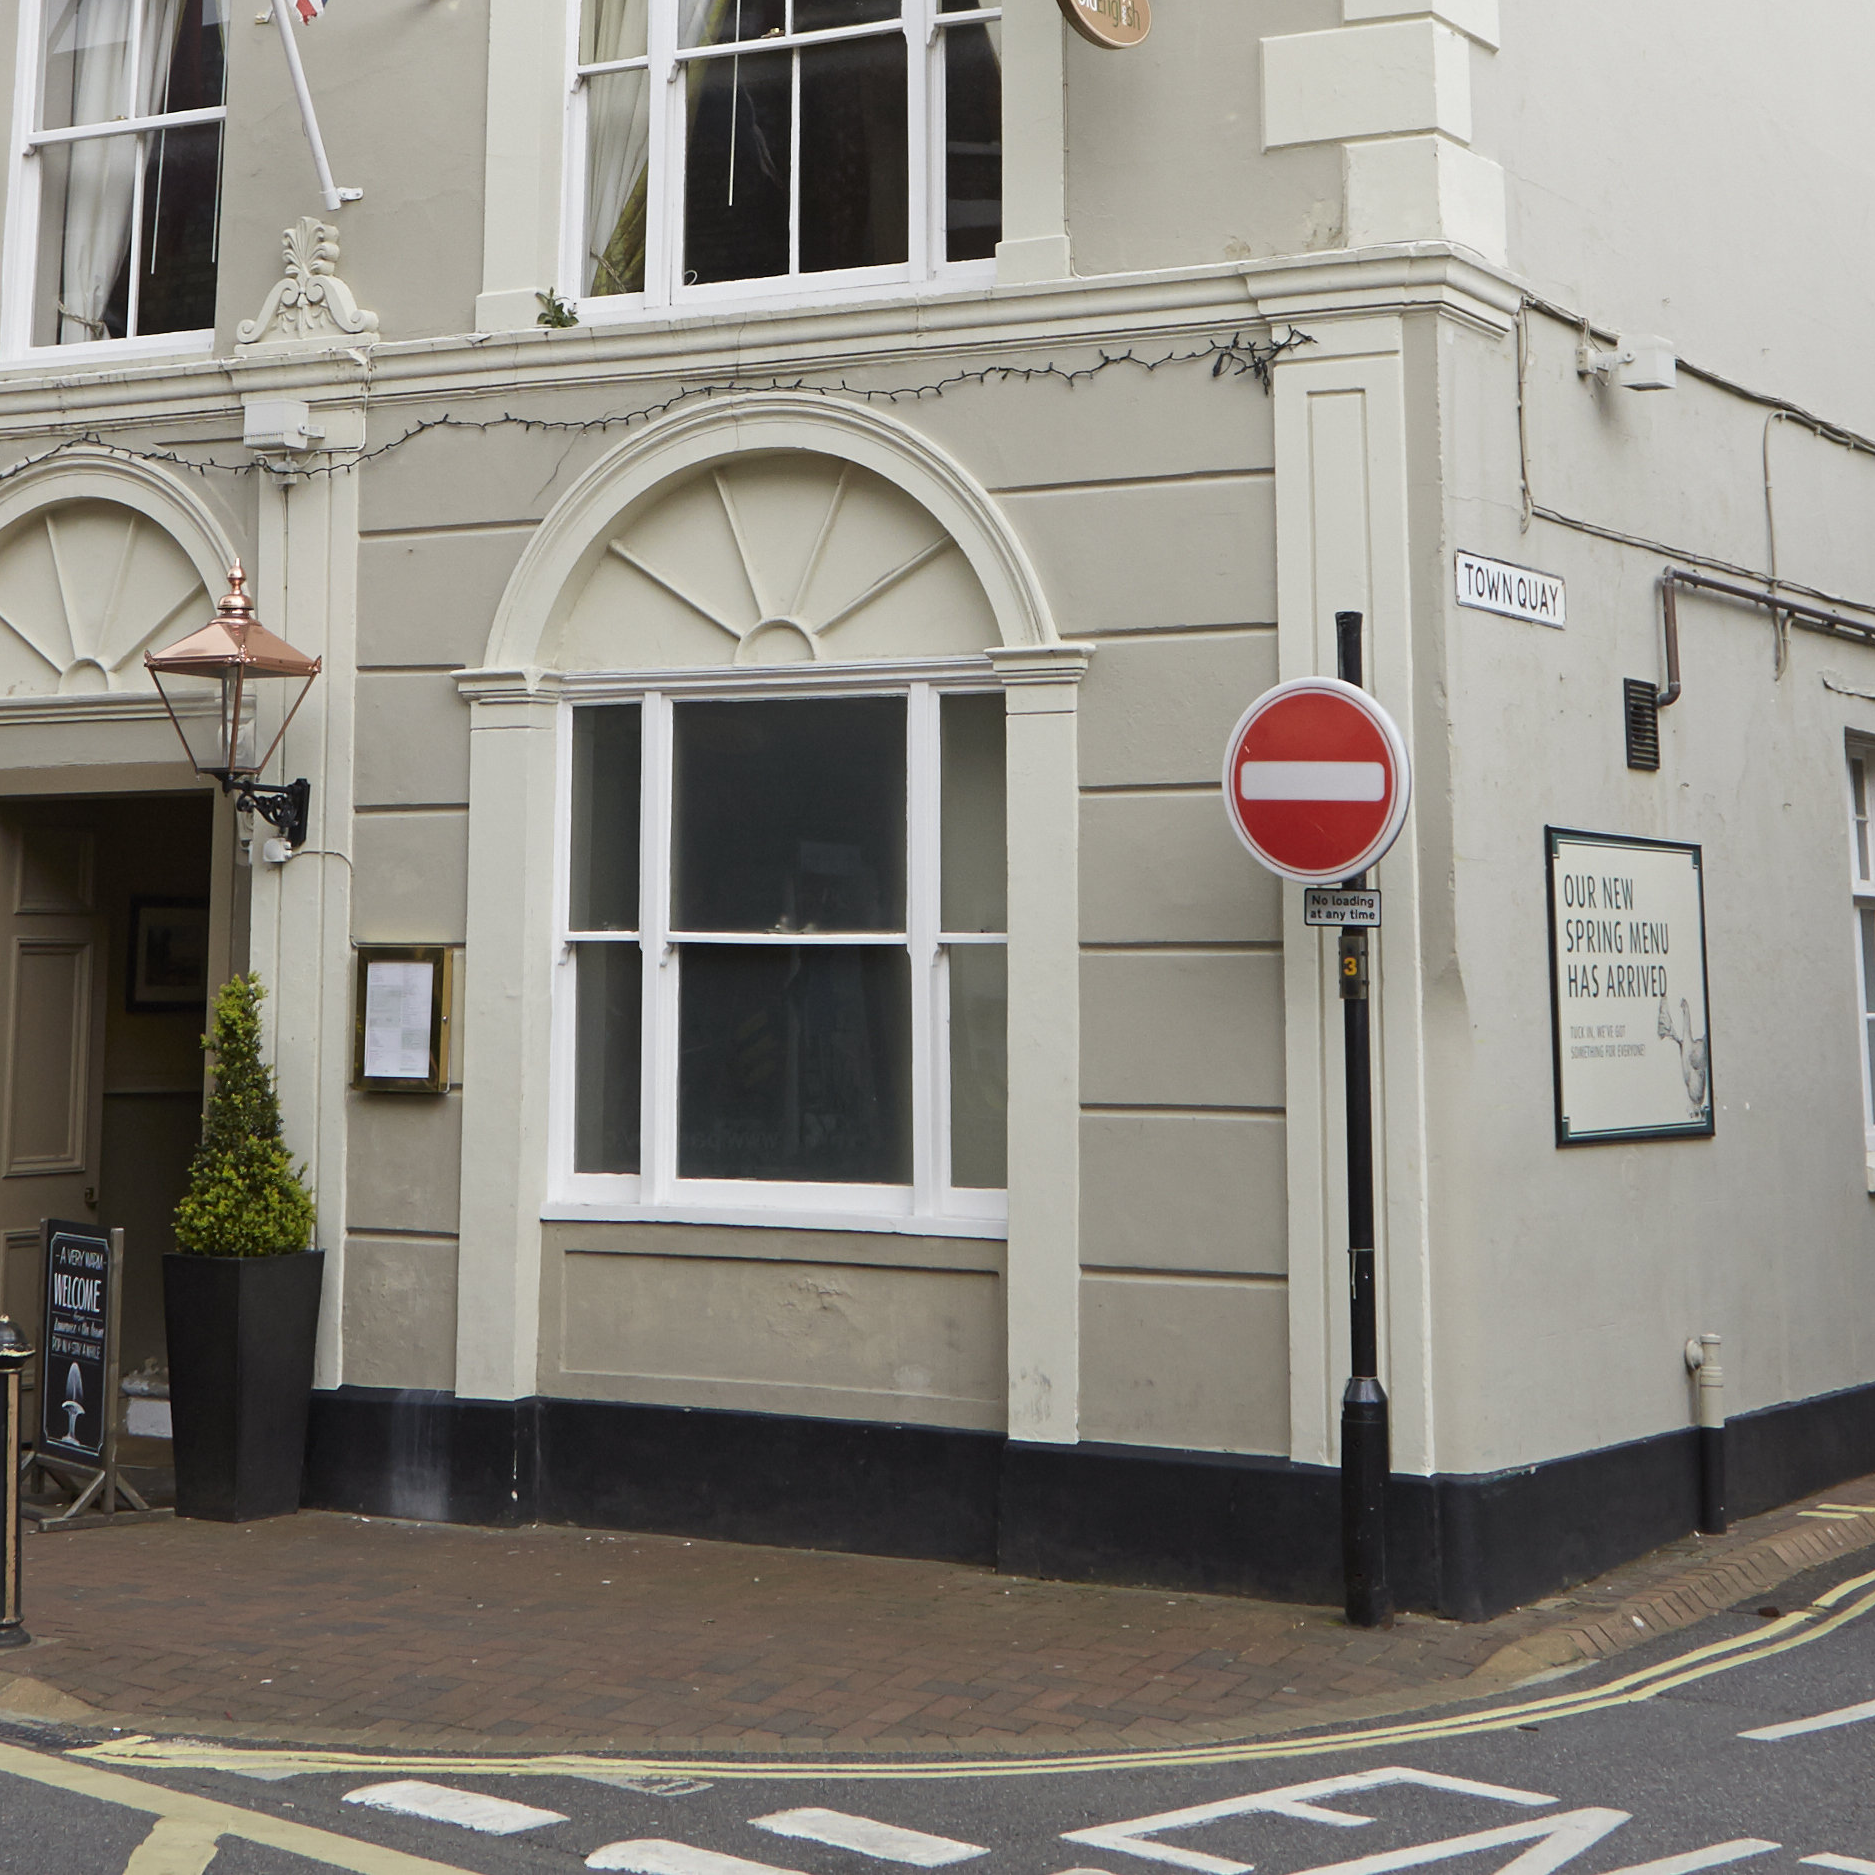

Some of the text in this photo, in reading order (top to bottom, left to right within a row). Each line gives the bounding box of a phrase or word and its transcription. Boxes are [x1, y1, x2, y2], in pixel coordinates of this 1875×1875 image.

[1464, 562, 1559, 617] TOWN QUAY
[1311, 895, 1374, 908] No loading
[1564, 874, 1634, 911] OUR NEW
[1310, 909, 1375, 921] at any time
[1566, 919, 1669, 955] SPRING MENU
[1343, 957, 1358, 976] 3
[1568, 964, 1668, 998] HAS ARRIVED
[1571, 1045, 1604, 1060] SOMETHING
[1605, 1045, 1616, 1058] FOR
[54, 1272, 102, 1313] WELCOME
